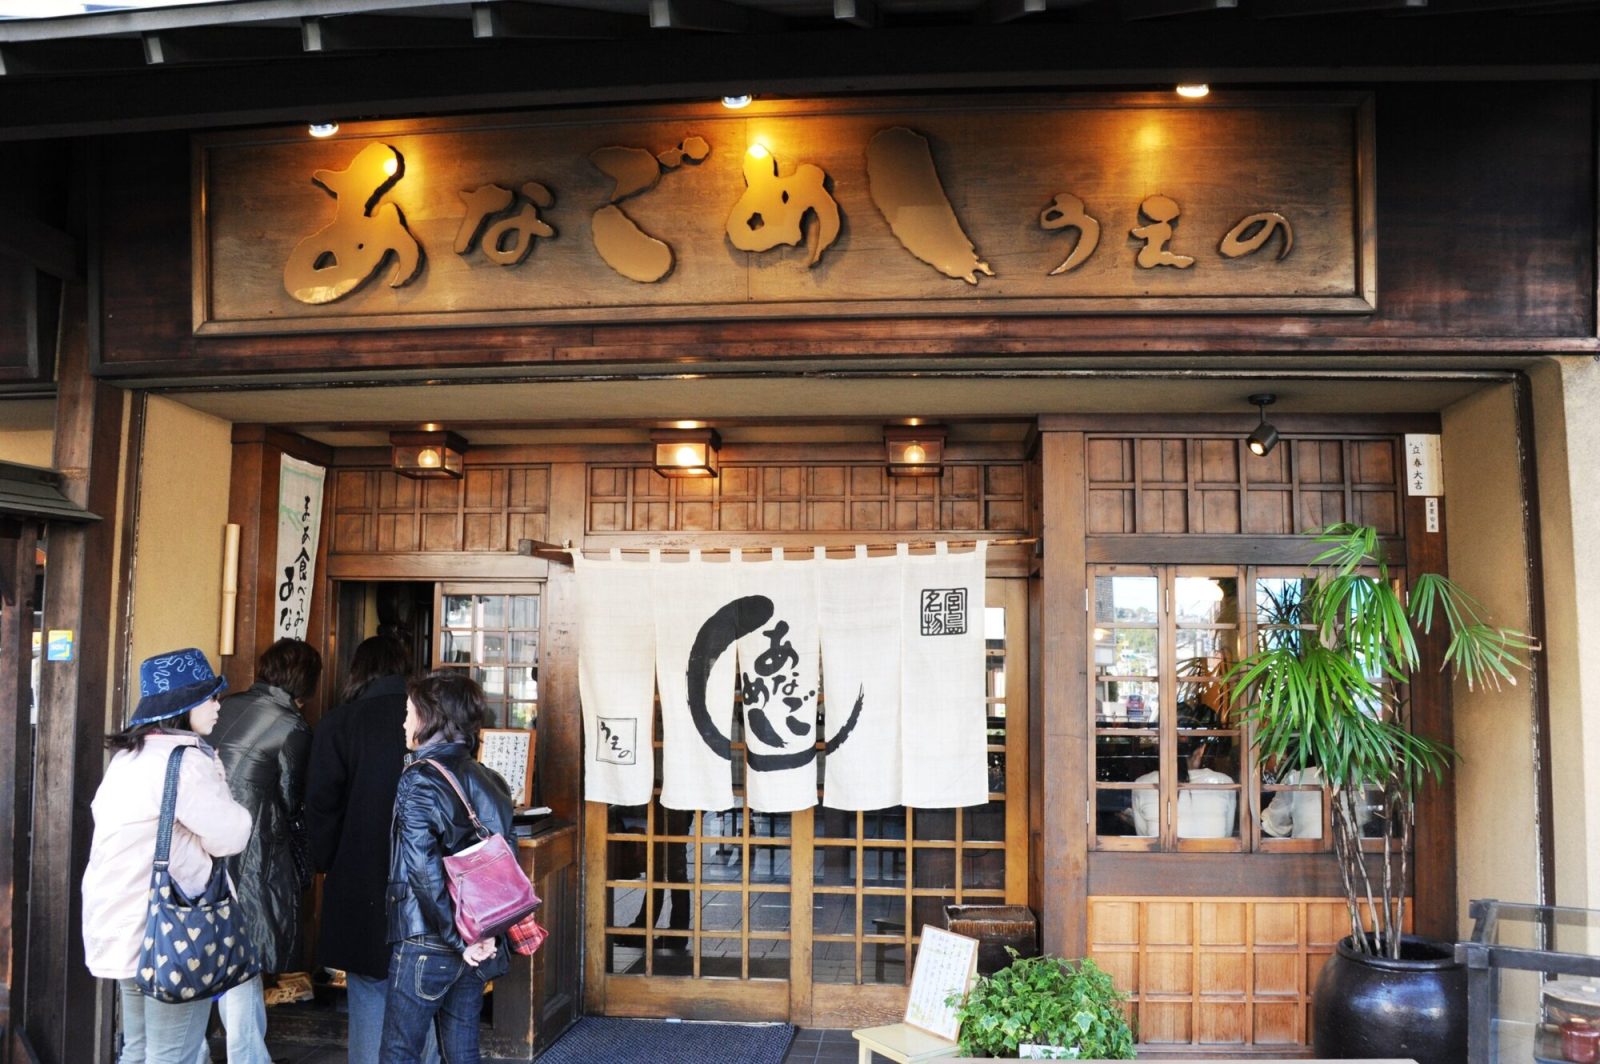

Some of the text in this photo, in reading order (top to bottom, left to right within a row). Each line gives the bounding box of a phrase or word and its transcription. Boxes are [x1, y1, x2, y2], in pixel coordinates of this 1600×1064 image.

[283, 127, 1293, 304] あなごめし うえの
[1412, 445, 1424, 490] 立春大吉
[279, 566, 295, 637] あな
[924, 590, 943, 634] 名物
[943, 589, 964, 634] 宮島
[754, 620, 816, 736] あなご
[742, 672, 789, 749] めし
[600, 721, 633, 759] うえの
